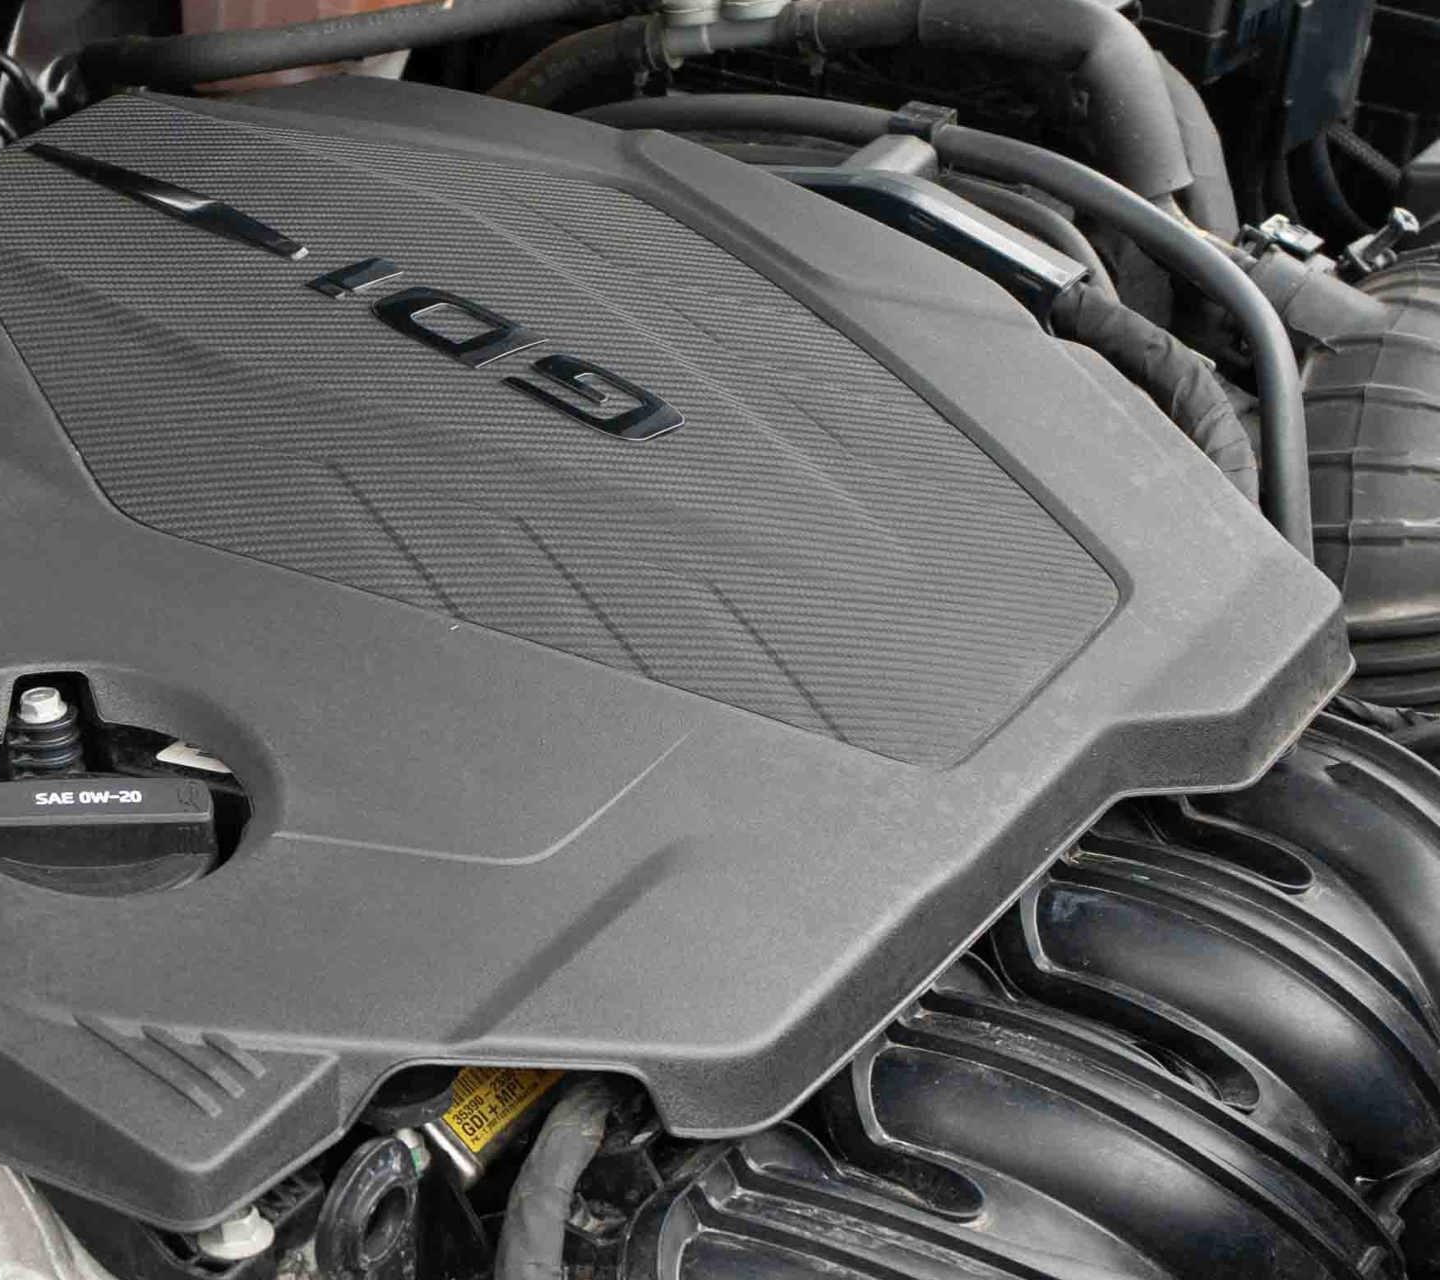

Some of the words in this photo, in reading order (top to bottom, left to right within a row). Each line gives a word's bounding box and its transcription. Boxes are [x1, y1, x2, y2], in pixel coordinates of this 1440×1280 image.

[34, 791, 75, 806] SAE
[78, 789, 143, 804] 0W-20
[452, 1094, 485, 1126] 35390
[461, 1110, 489, 1137] GDI
[496, 1077, 526, 1108] MPI
